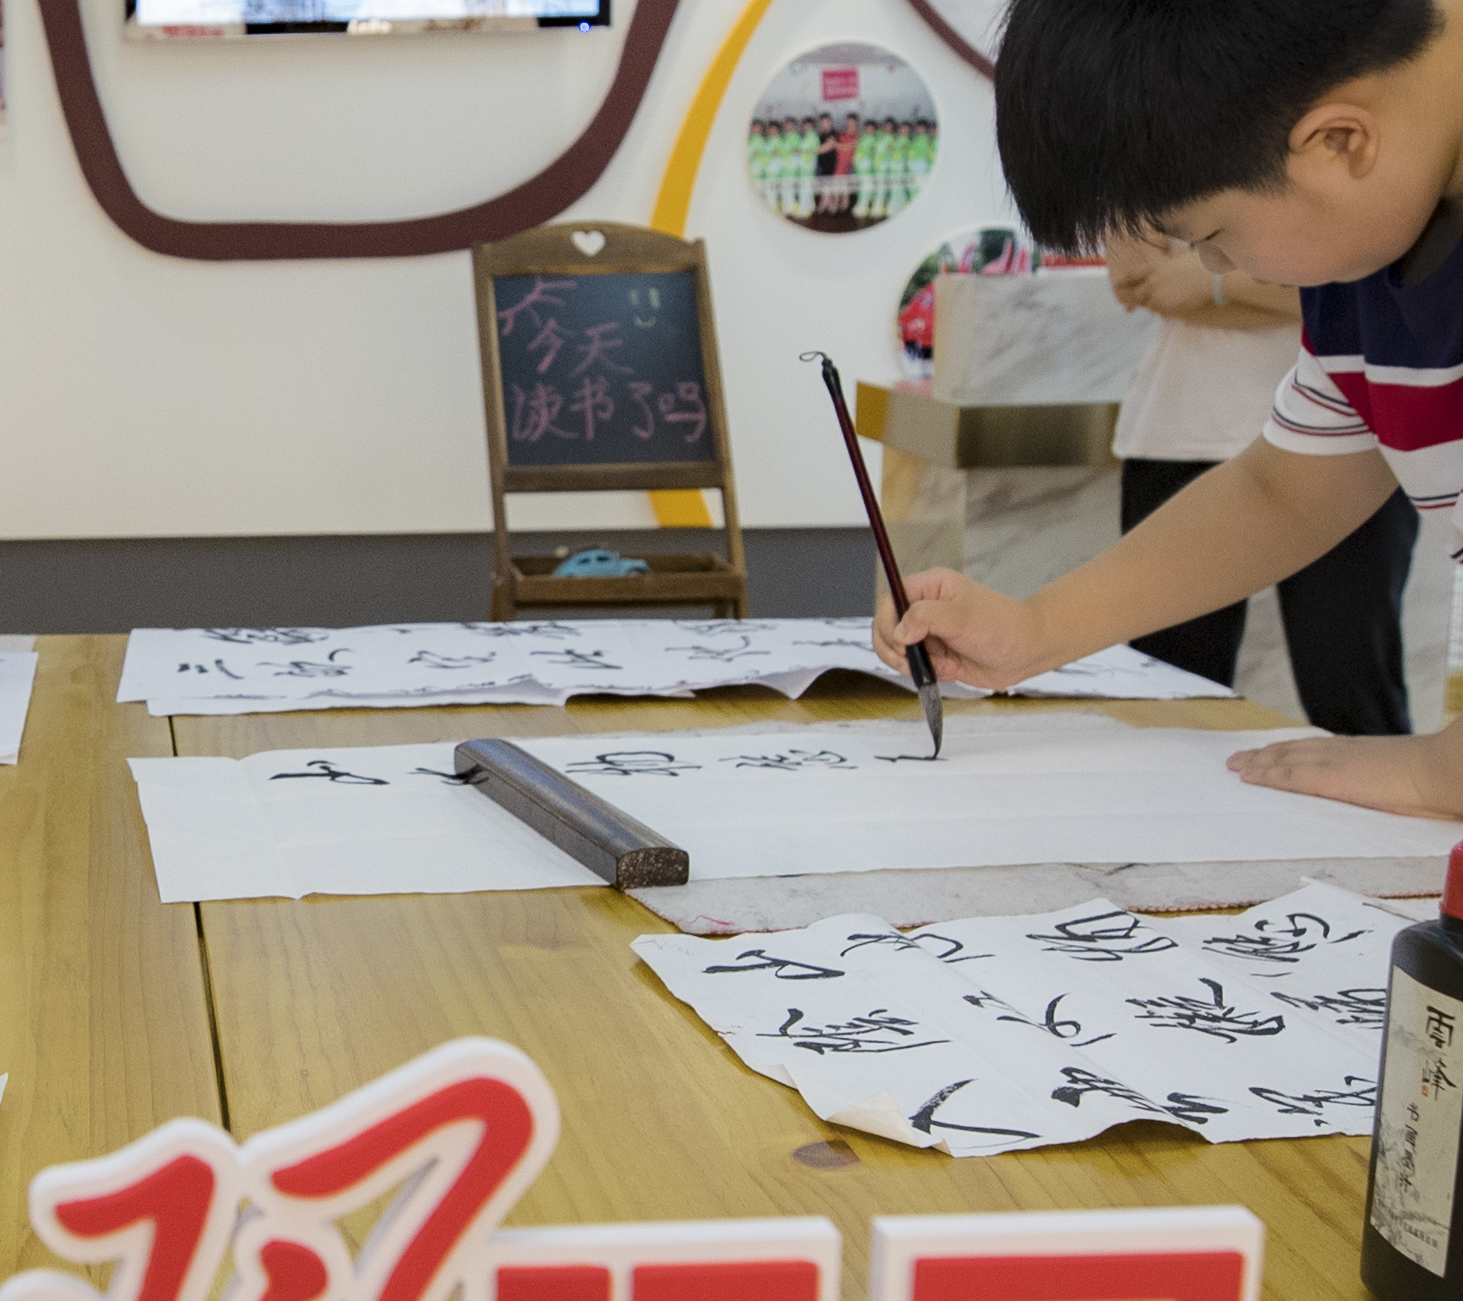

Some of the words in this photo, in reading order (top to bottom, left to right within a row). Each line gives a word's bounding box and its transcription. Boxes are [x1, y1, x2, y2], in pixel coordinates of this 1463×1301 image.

[527, 317, 634, 378] 今天
[510, 374, 708, 443] 读书了吗
